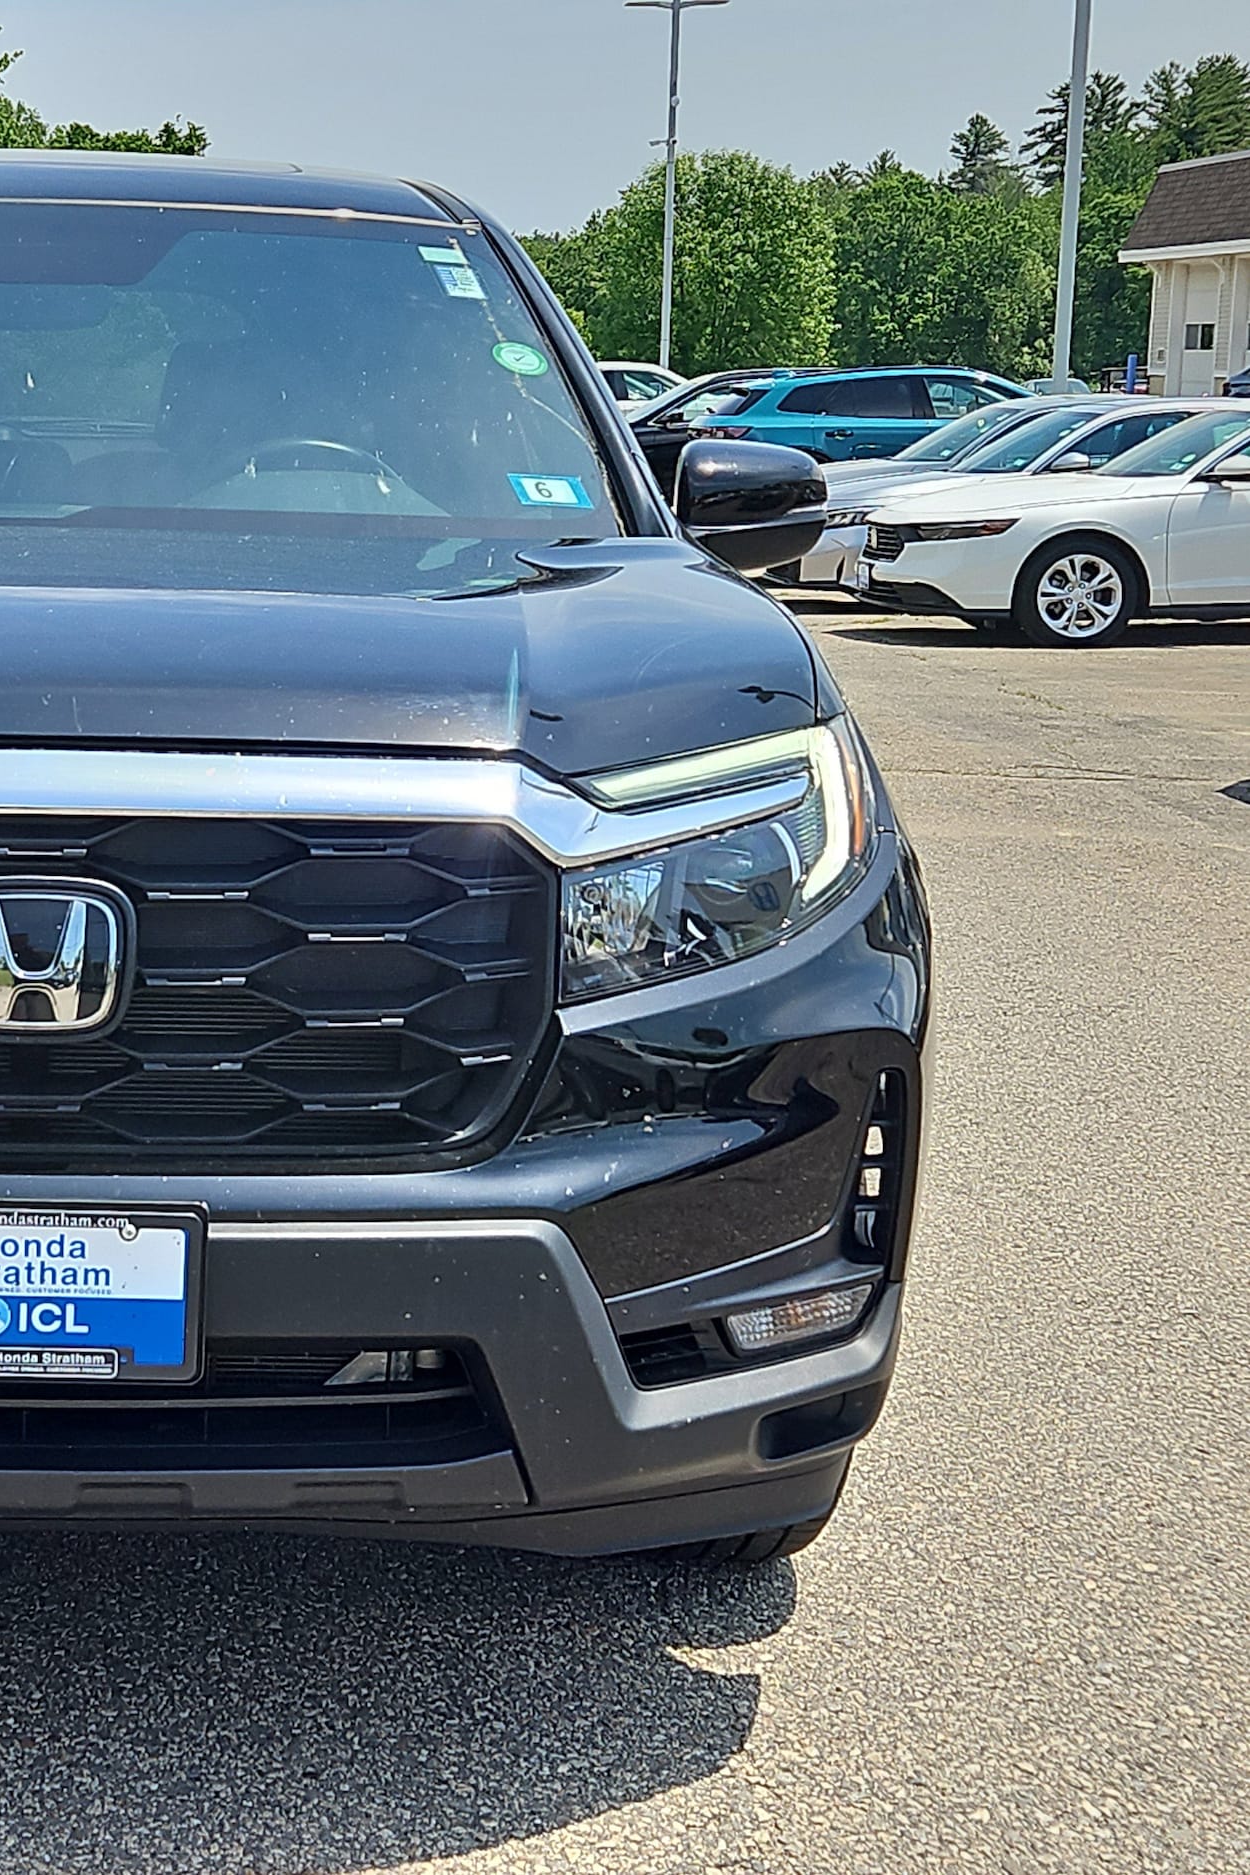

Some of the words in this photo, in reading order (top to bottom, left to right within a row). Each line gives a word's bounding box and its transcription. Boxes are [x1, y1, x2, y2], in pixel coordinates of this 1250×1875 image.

[534, 481, 553, 498] 6
[18, 1302, 90, 1334] ICL
[41, 1352, 106, 1365] Stratham
